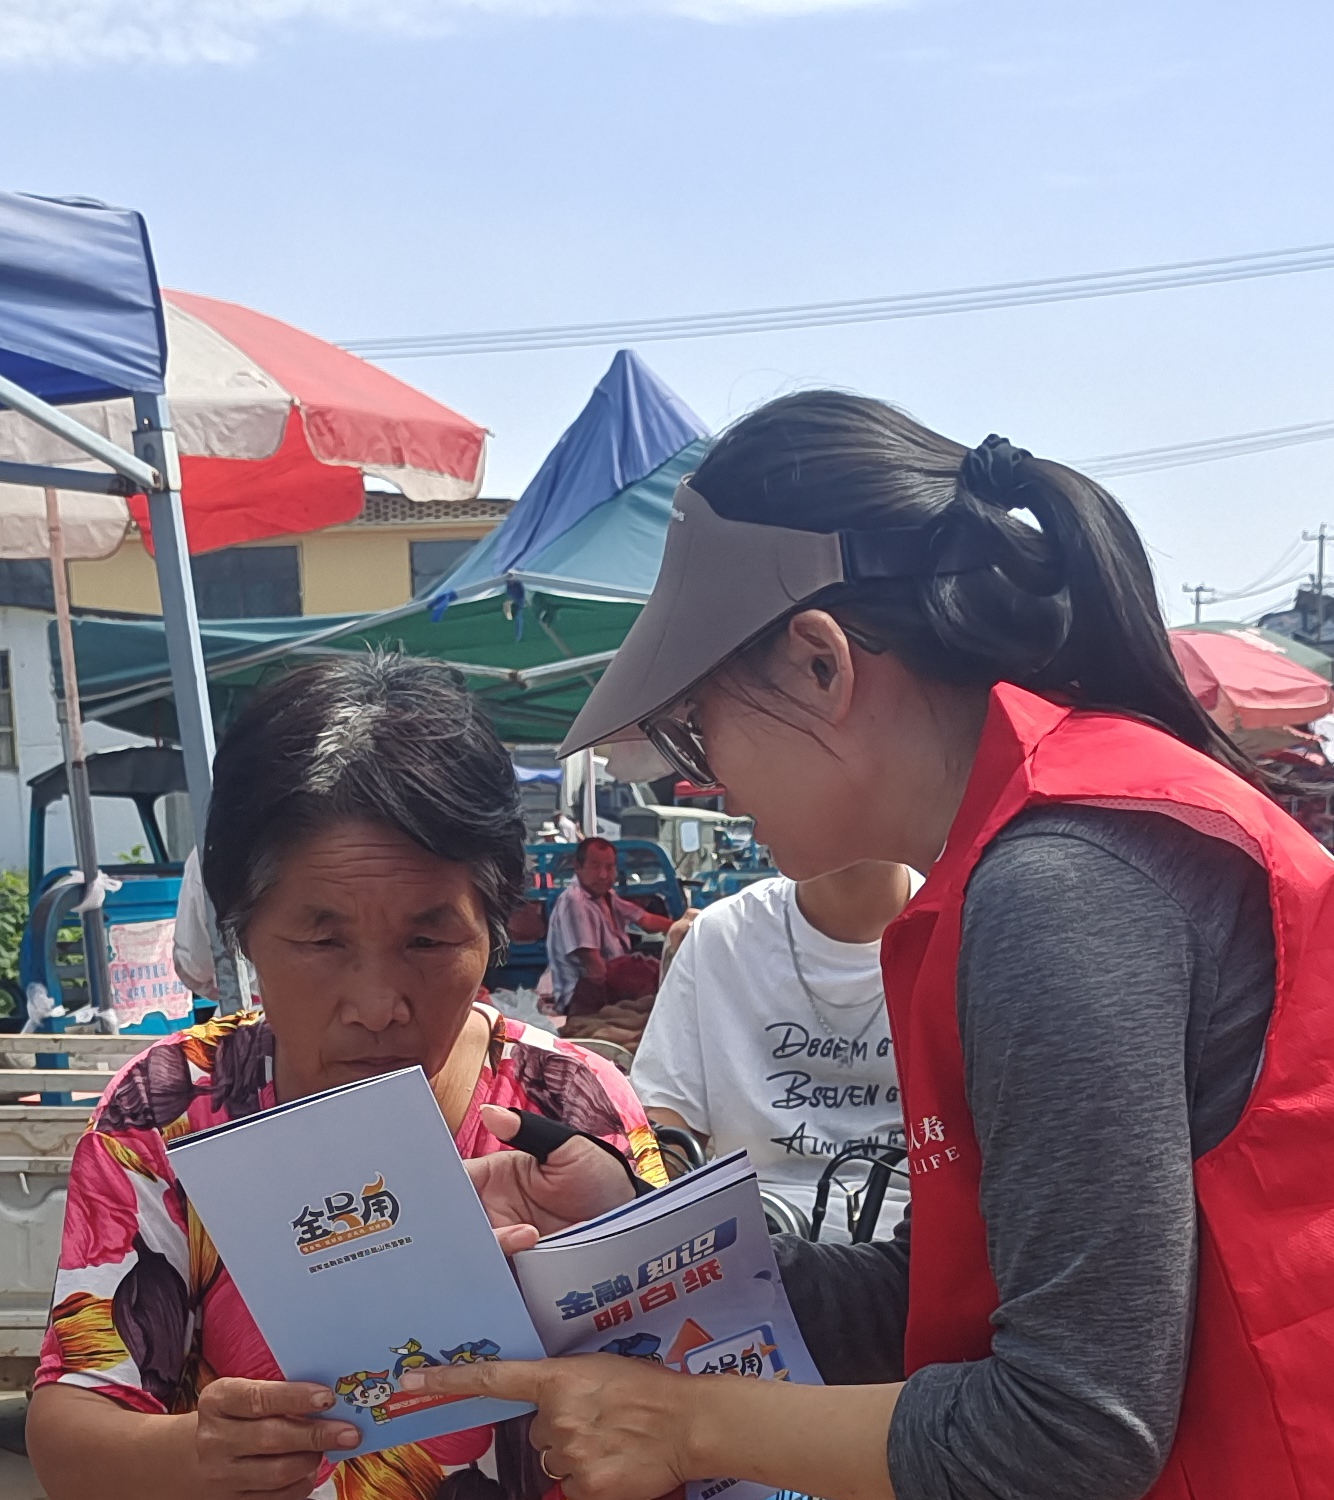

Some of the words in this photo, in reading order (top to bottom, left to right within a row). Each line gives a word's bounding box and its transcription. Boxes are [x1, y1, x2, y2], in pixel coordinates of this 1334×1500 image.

[555, 1228, 717, 1321] 金融知识
[592, 1257, 724, 1333] 明白纸
